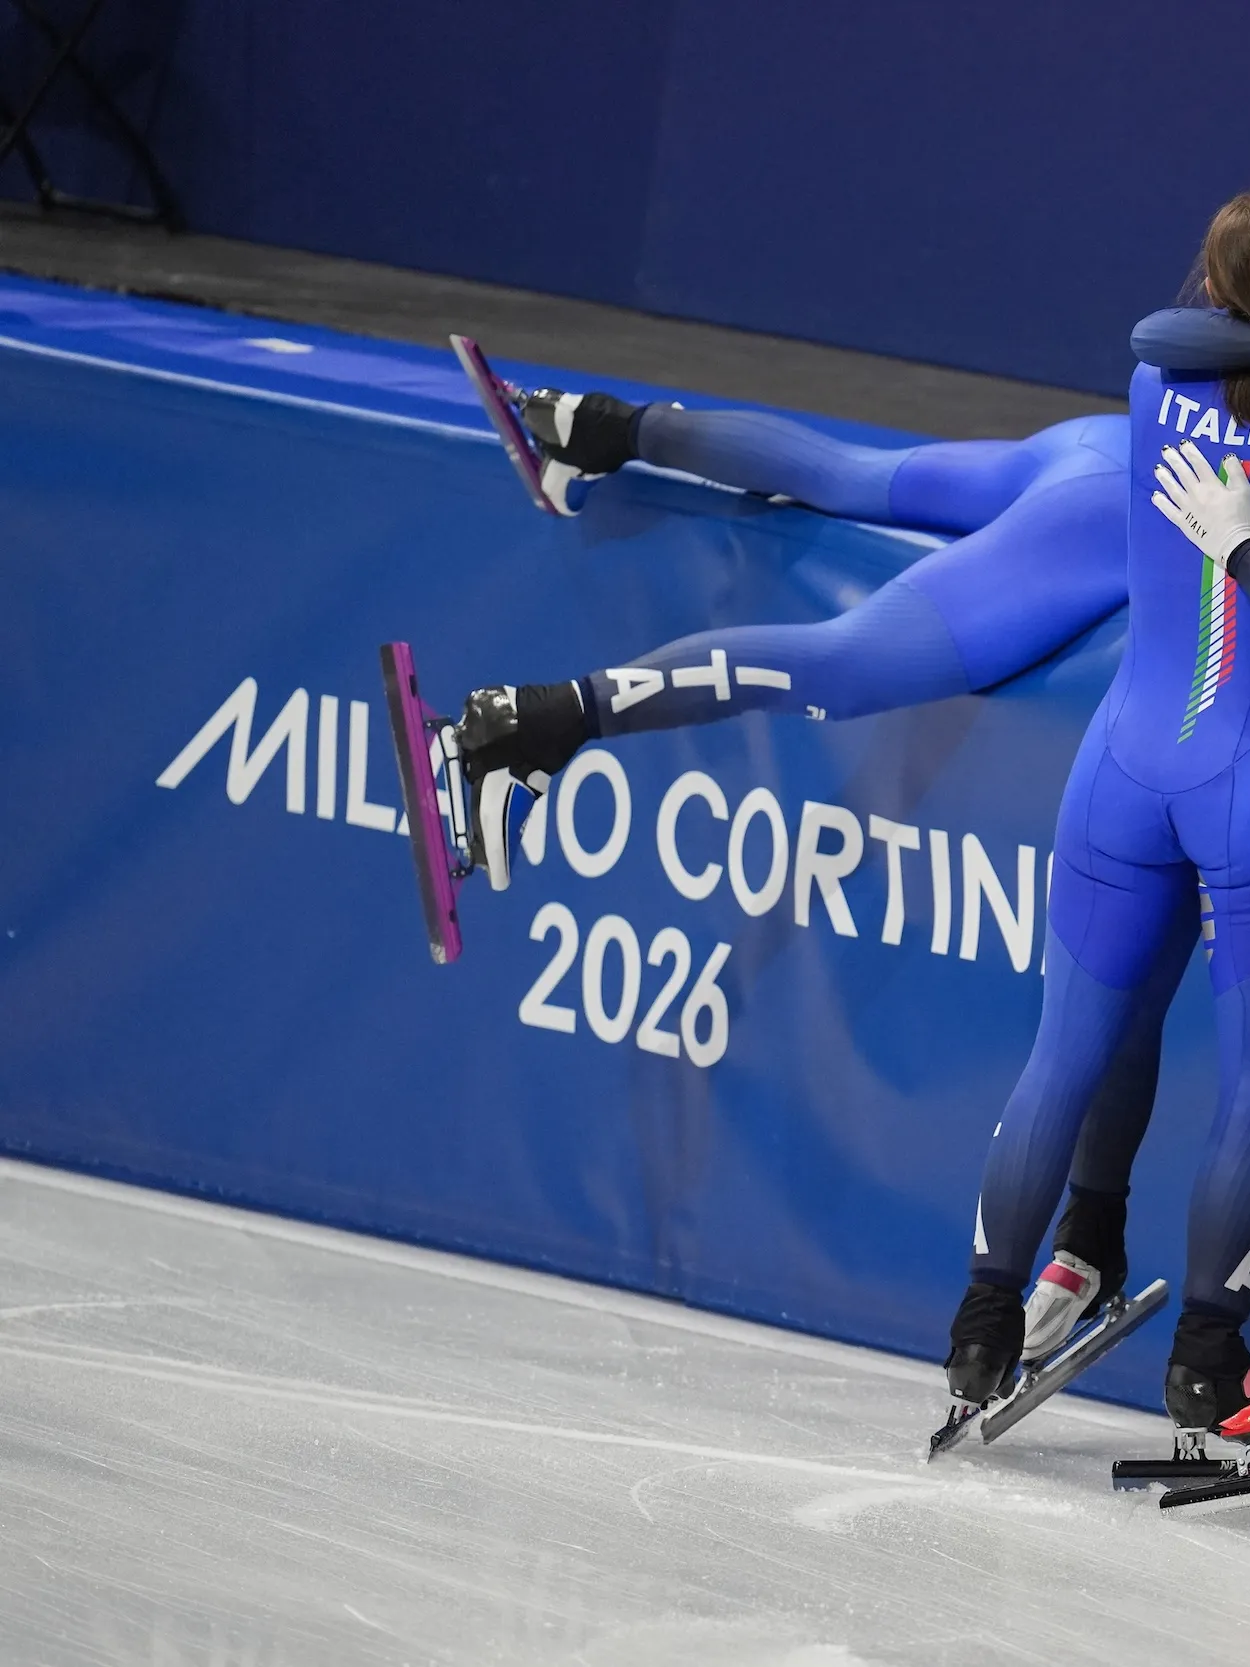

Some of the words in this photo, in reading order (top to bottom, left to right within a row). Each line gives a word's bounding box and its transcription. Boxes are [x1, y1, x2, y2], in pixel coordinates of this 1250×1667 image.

[1185, 511, 1208, 539] ITALY
[605, 649, 791, 714] ITA
[656, 770, 1054, 975] CORTIN
[518, 902, 731, 1069] 2026
